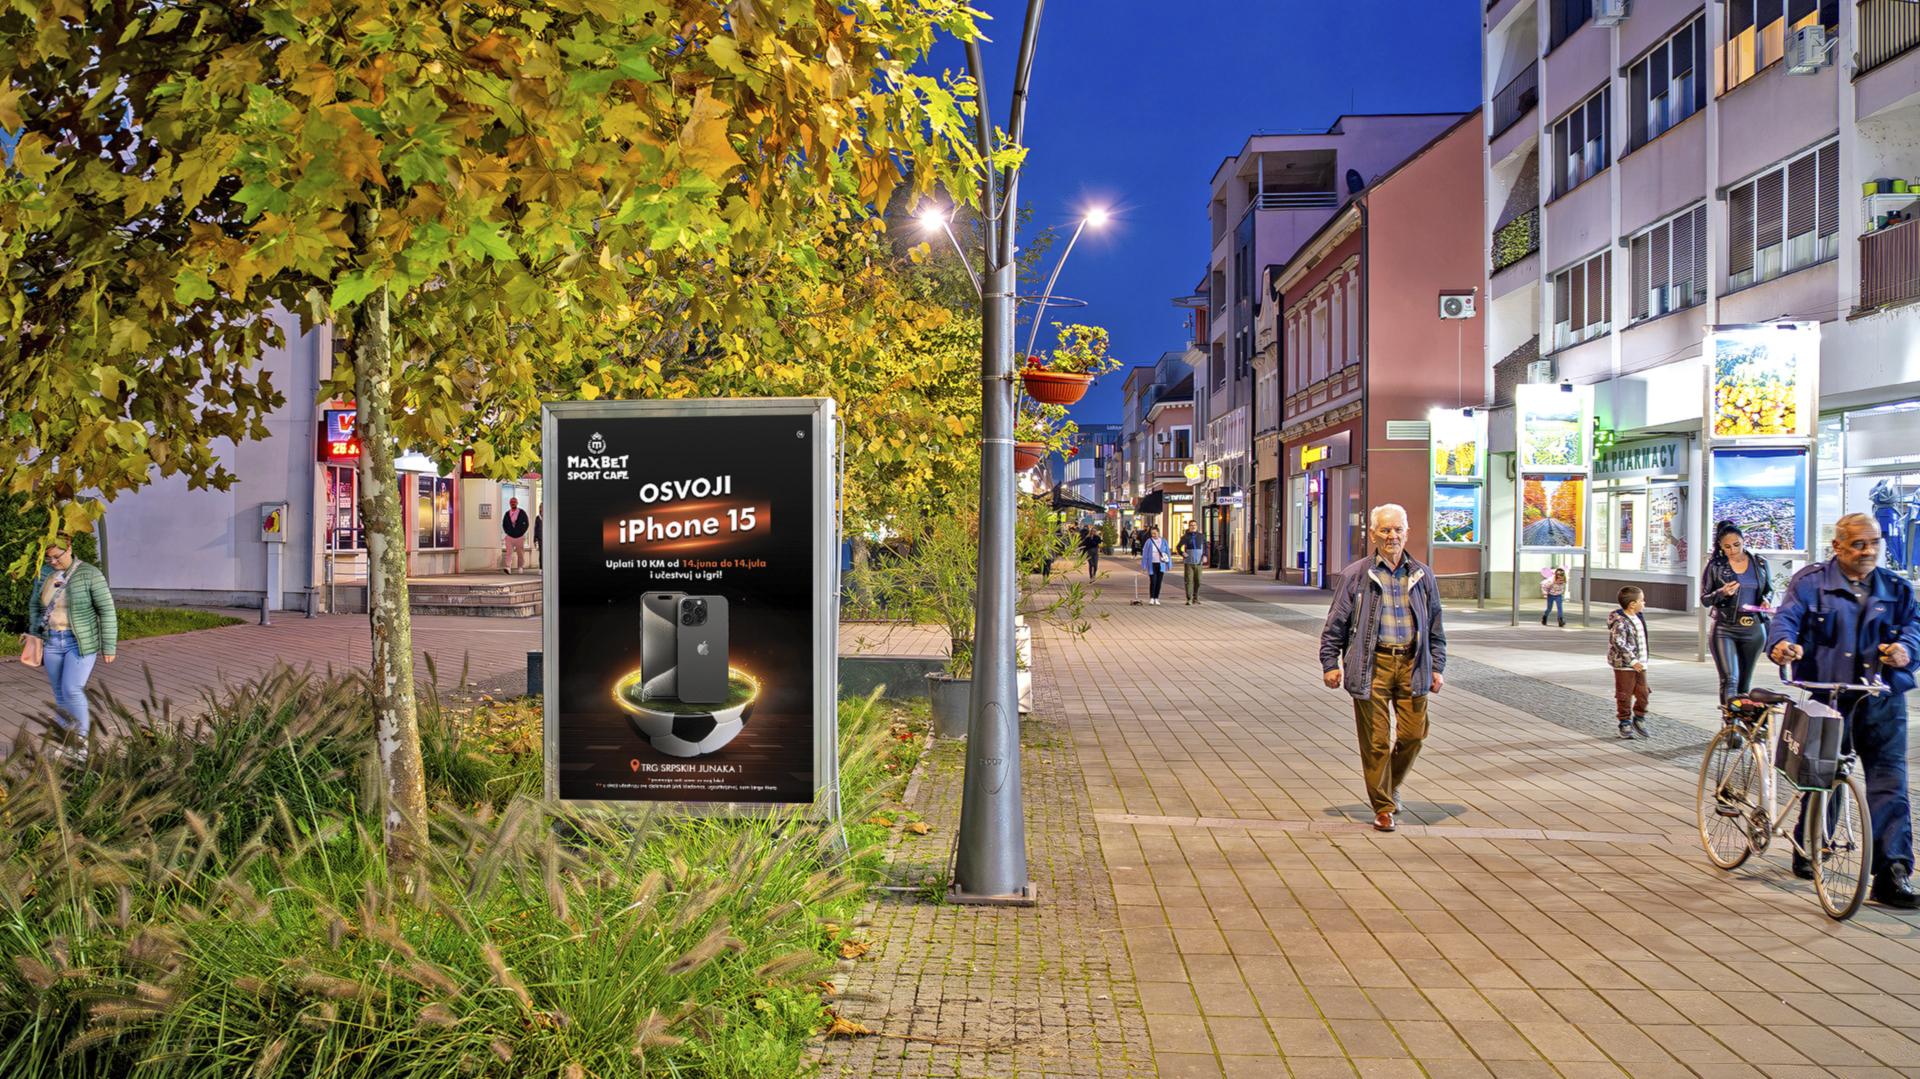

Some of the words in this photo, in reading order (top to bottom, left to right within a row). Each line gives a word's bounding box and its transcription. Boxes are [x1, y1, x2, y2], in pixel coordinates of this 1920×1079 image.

[567, 454, 629, 469] MAXBET
[1612, 444, 1676, 472] PHARMACY
[567, 471, 601, 480] SPORT
[639, 475, 732, 503] OSVOJI
[619, 516, 720, 544] iPhone
[727, 507, 756, 532] 15
[605, 559, 634, 570] Uplati
[636, 559, 647, 568] 10
[649, 559, 665, 568] KM
[667, 559, 679, 568] od
[682, 559, 718, 570] 14.juna
[720, 559, 732, 568] do
[734, 559, 767, 570] 14.jula
[655, 570, 693, 581] učestvuj
[703, 570, 723, 580] igri!
[641, 763, 659, 773] TRG
[661, 763, 696, 773] SRPSKIH
[699, 763, 735, 773] JUNAKA
